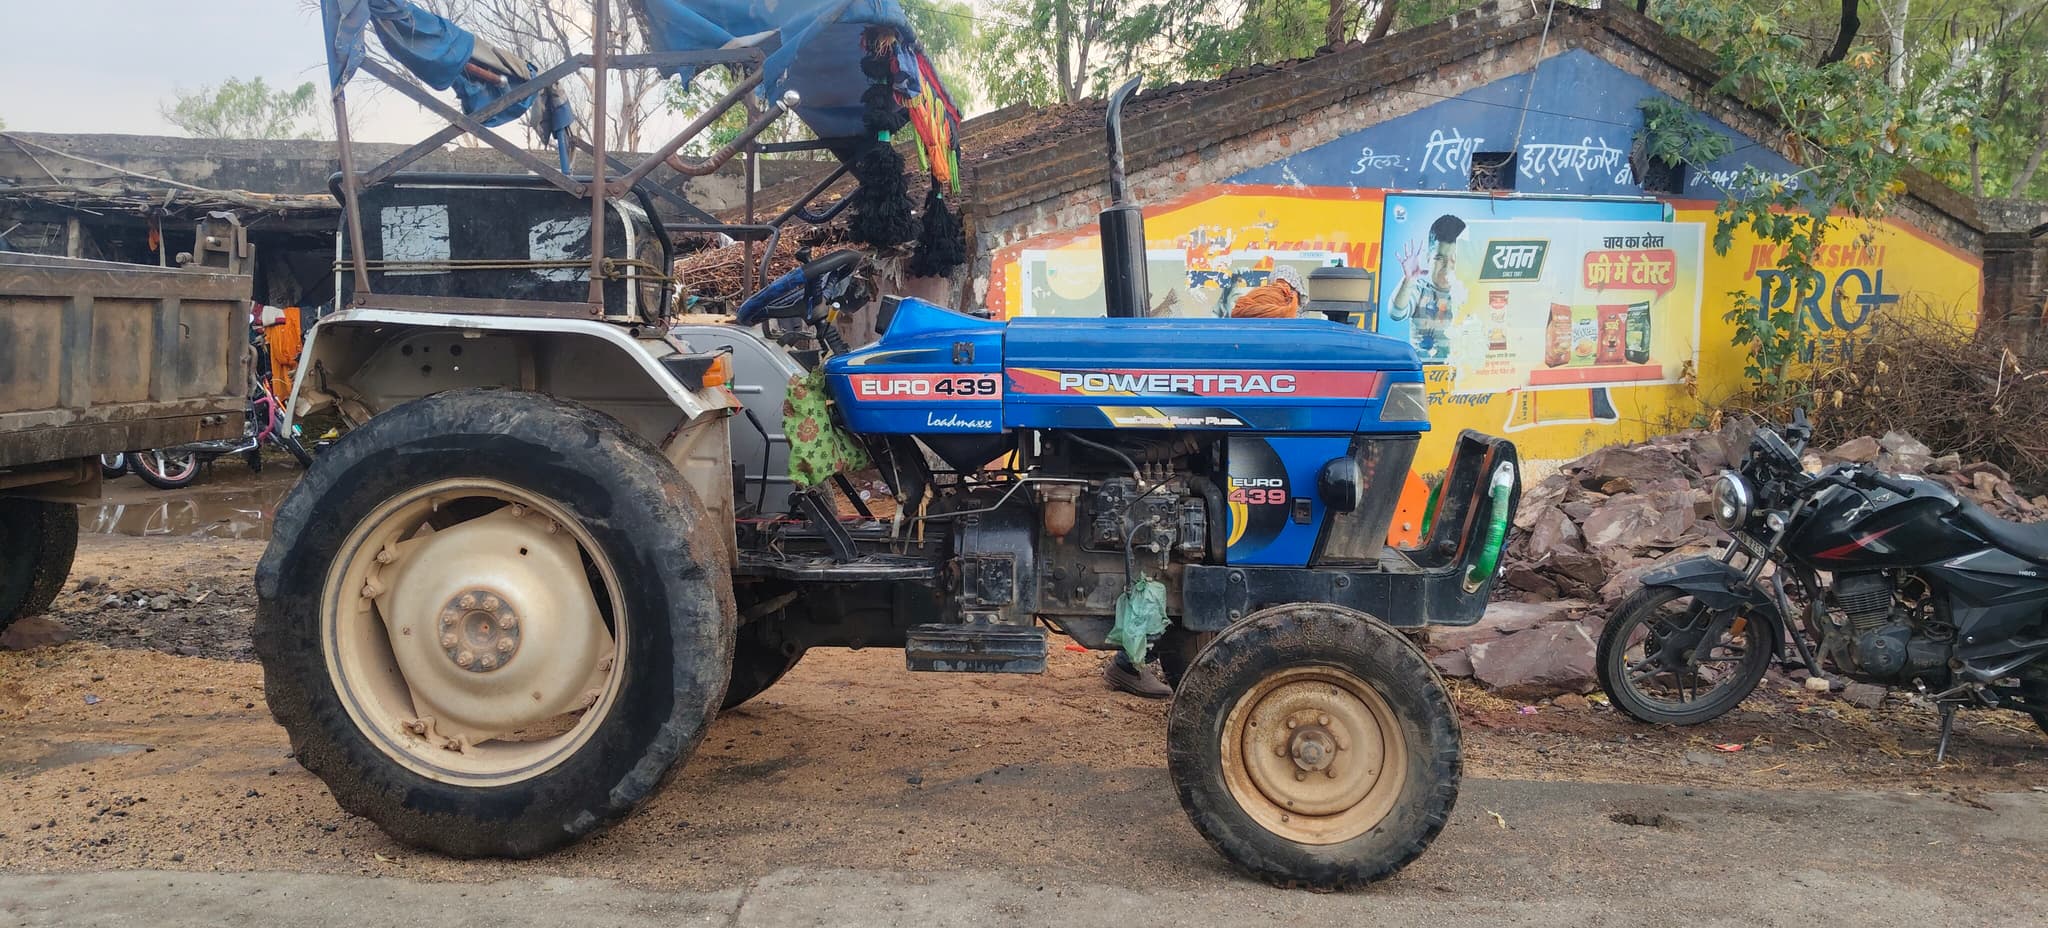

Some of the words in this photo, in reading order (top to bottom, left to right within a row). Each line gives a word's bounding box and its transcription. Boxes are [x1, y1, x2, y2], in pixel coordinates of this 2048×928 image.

[1419, 127, 1485, 176] रितेश
[1603, 236, 1624, 249] चाय
[1625, 236, 1640, 249] का
[1641, 231, 1664, 249] दोस्त
[1587, 254, 1612, 286] फ्री
[1613, 253, 1631, 284] में
[1631, 253, 1672, 285] टोस्ट
[861, 379, 930, 395] EURO
[934, 378, 996, 396] 439
[1059, 373, 1297, 393] POWERTRAC
[927, 411, 993, 429] Loadmaxx
[1232, 478, 1283, 487] EURO
[1229, 488, 1286, 505] 439
